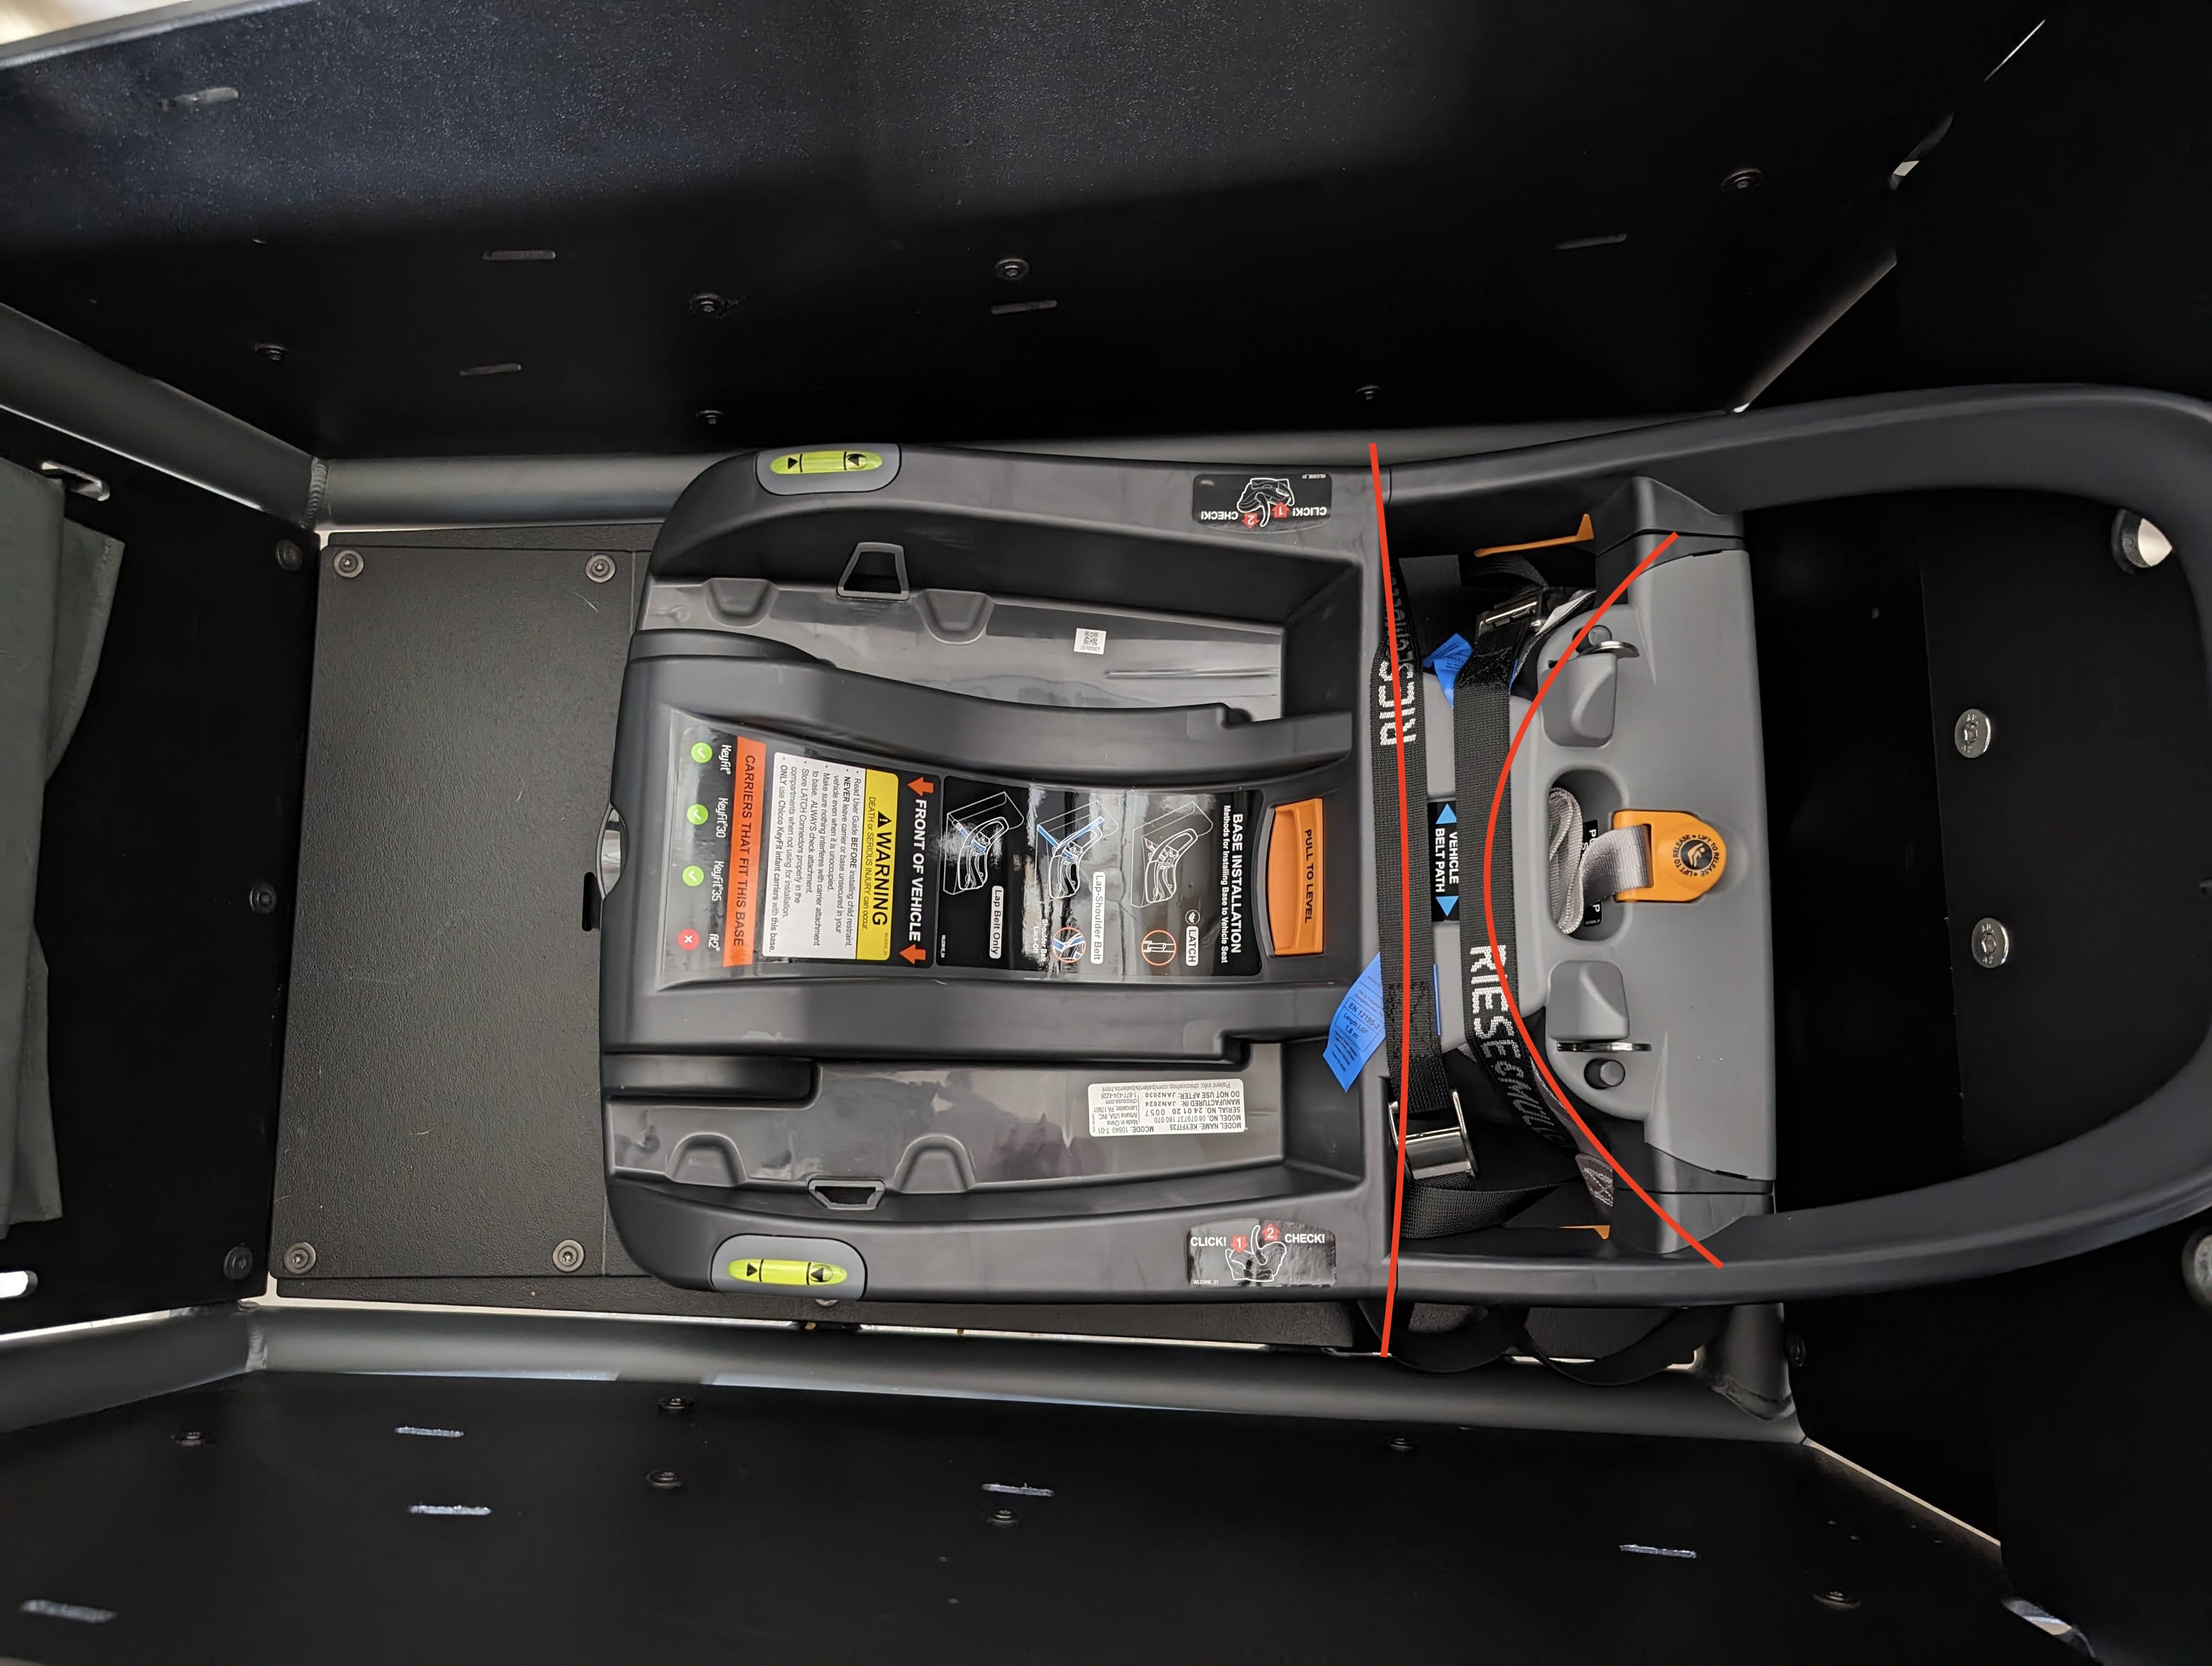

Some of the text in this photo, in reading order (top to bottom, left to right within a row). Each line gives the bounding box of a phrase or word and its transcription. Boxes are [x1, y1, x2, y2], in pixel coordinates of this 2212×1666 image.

[1201, 511, 1238, 520] CHECK!
[1248, 515, 1255, 524] 2
[1278, 507, 1284, 515] 1
[1293, 507, 1327, 516] CLICK!
[789, 767, 797, 815] compartments
[800, 789, 808, 813] LATCH
[777, 800, 785, 824] Chicco
[818, 810, 827, 834] nothing
[775, 826, 783, 849] KeyFit
[798, 815, 806, 853] Connectors
[865, 832, 873, 865] SERIOUS
[734, 755, 755, 946] CARRIERS THAT FIT THIS BASE
[785, 849, 793, 867] using
[850, 837, 858, 868] BEFORE
[1435, 828, 1445, 892] BELT PATH
[1449, 831, 1459, 884] VEHICLE
[1673, 834, 1693, 877] LIFT TO RELEASE
[1698, 834, 1720, 876] LIFT TO RELEASE
[795, 855, 804, 882] properly
[806, 855, 814, 894] attachment.
[827, 851, 835, 891] unoccupied.
[872, 832, 892, 926] WARNING
[909, 799, 927, 941] FRONT OF VEHICLE
[1220, 851, 1230, 885] Installing
[1231, 813, 1243, 953] BASE INSTALLATION
[1305, 829, 1314, 924] PULL TO LEVEL
[773, 873, 781, 900] carriers
[837, 873, 845, 908] unsecured
[846, 870, 856, 899] installing
[813, 907, 822, 946] attachment
[845, 918, 853, 947] restraint.
[991, 889, 1002, 954] Lap Belt Only
[1094, 875, 1104, 960] Lap-Shoulder Belt
[1188, 930, 1197, 962] LATCH
[1343, 1013, 1358, 1027] Length
[1348, 1003, 1358, 1013] EN
[1357, 1010, 1381, 1029] 12195-2
[1191, 1236, 1226, 1247] CLICK!
[1236, 1238, 1242, 1247] 1
[1266, 1228, 1274, 1239] 2
[1285, 1234, 1325, 1244] CHECK!
